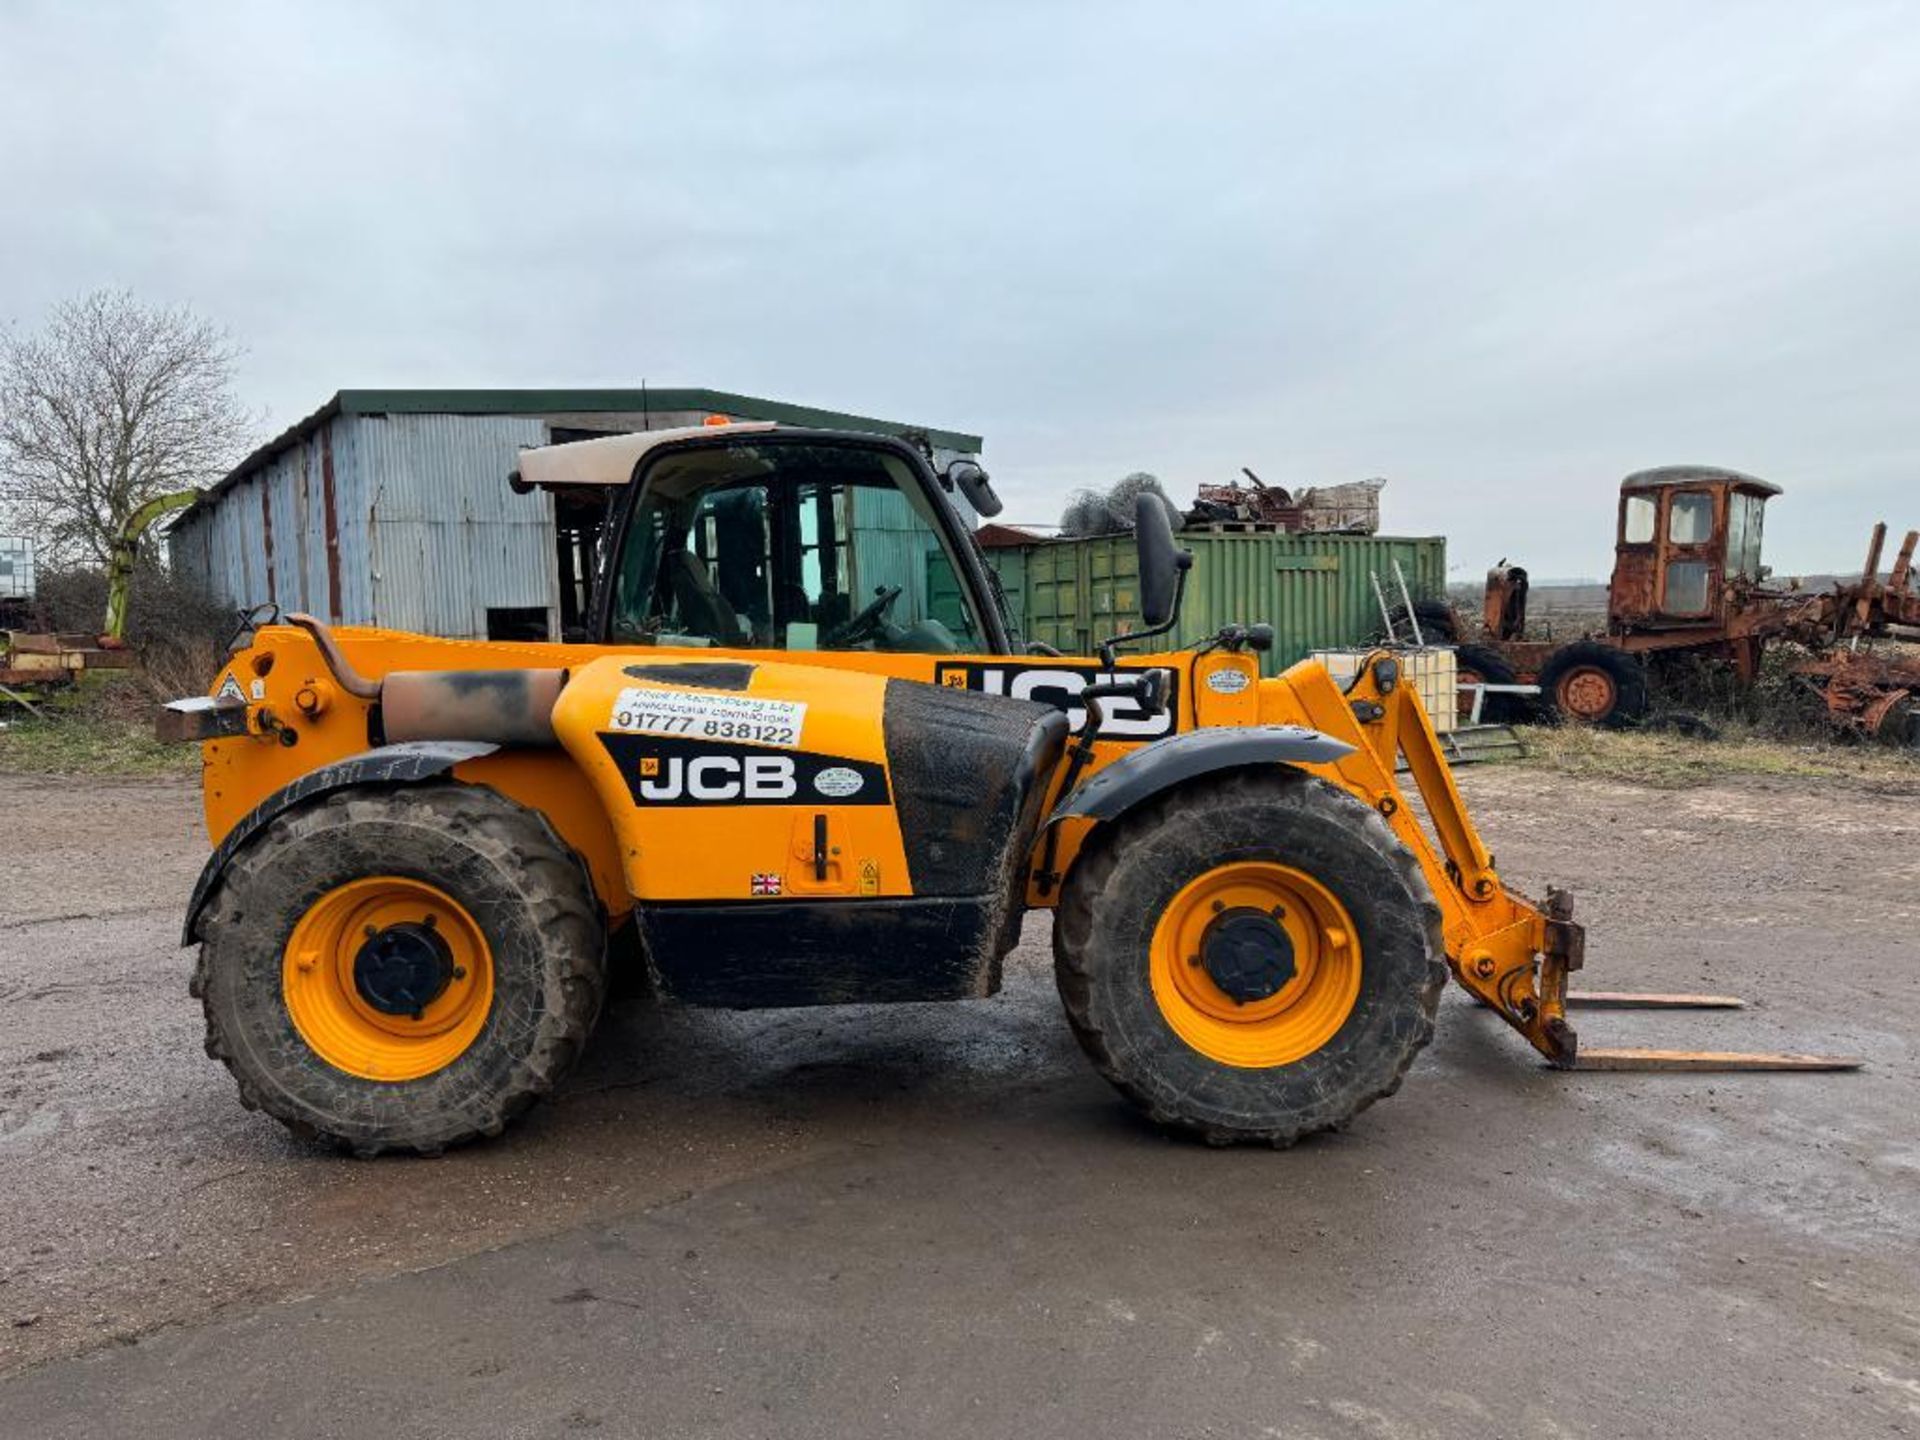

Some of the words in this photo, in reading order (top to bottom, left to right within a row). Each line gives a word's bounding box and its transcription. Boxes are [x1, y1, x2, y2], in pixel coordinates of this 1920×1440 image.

[617, 711, 695, 733] 01777
[703, 720, 793, 744] 838122
[640, 756, 797, 800] JCB
